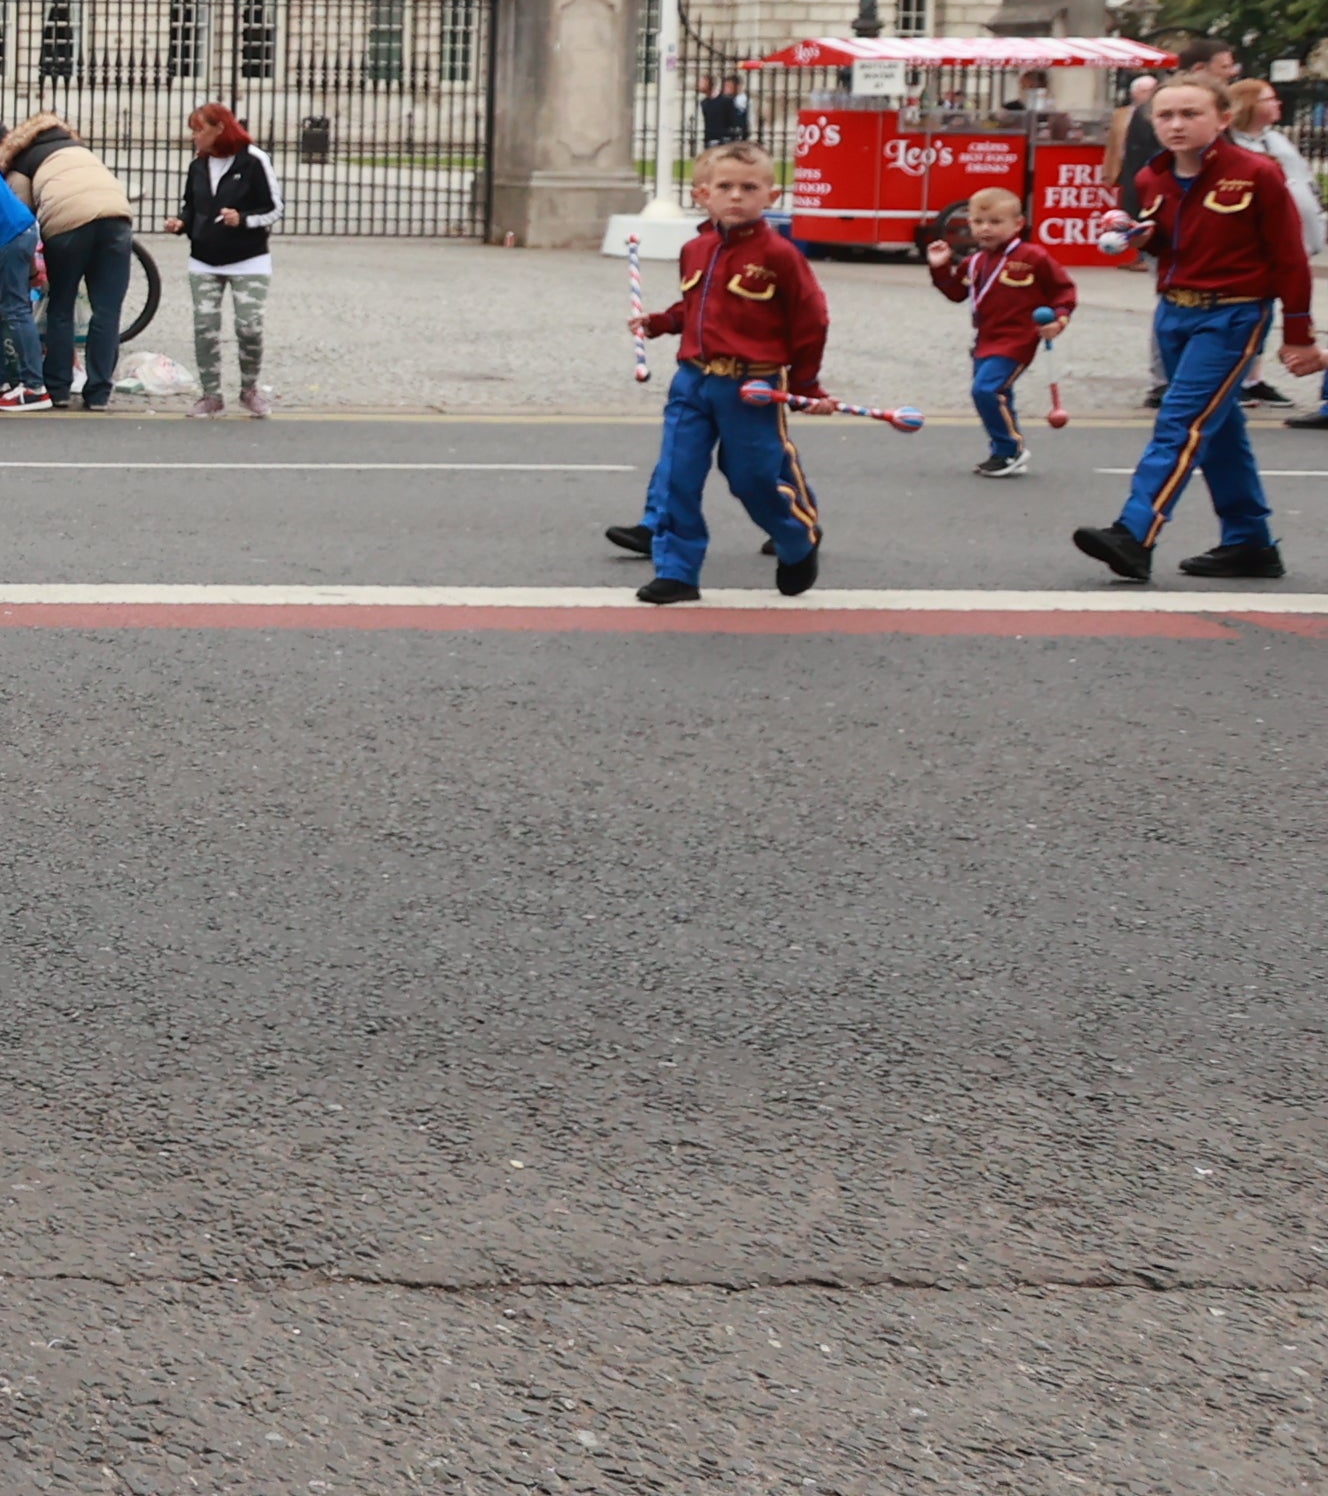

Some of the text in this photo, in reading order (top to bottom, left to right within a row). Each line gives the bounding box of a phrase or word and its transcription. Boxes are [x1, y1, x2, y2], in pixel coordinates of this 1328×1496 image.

[795, 115, 841, 158] eo's
[884, 139, 954, 177] Leo's
[1044, 187, 1121, 209] FREN
[1038, 211, 1104, 246] CRÊ
